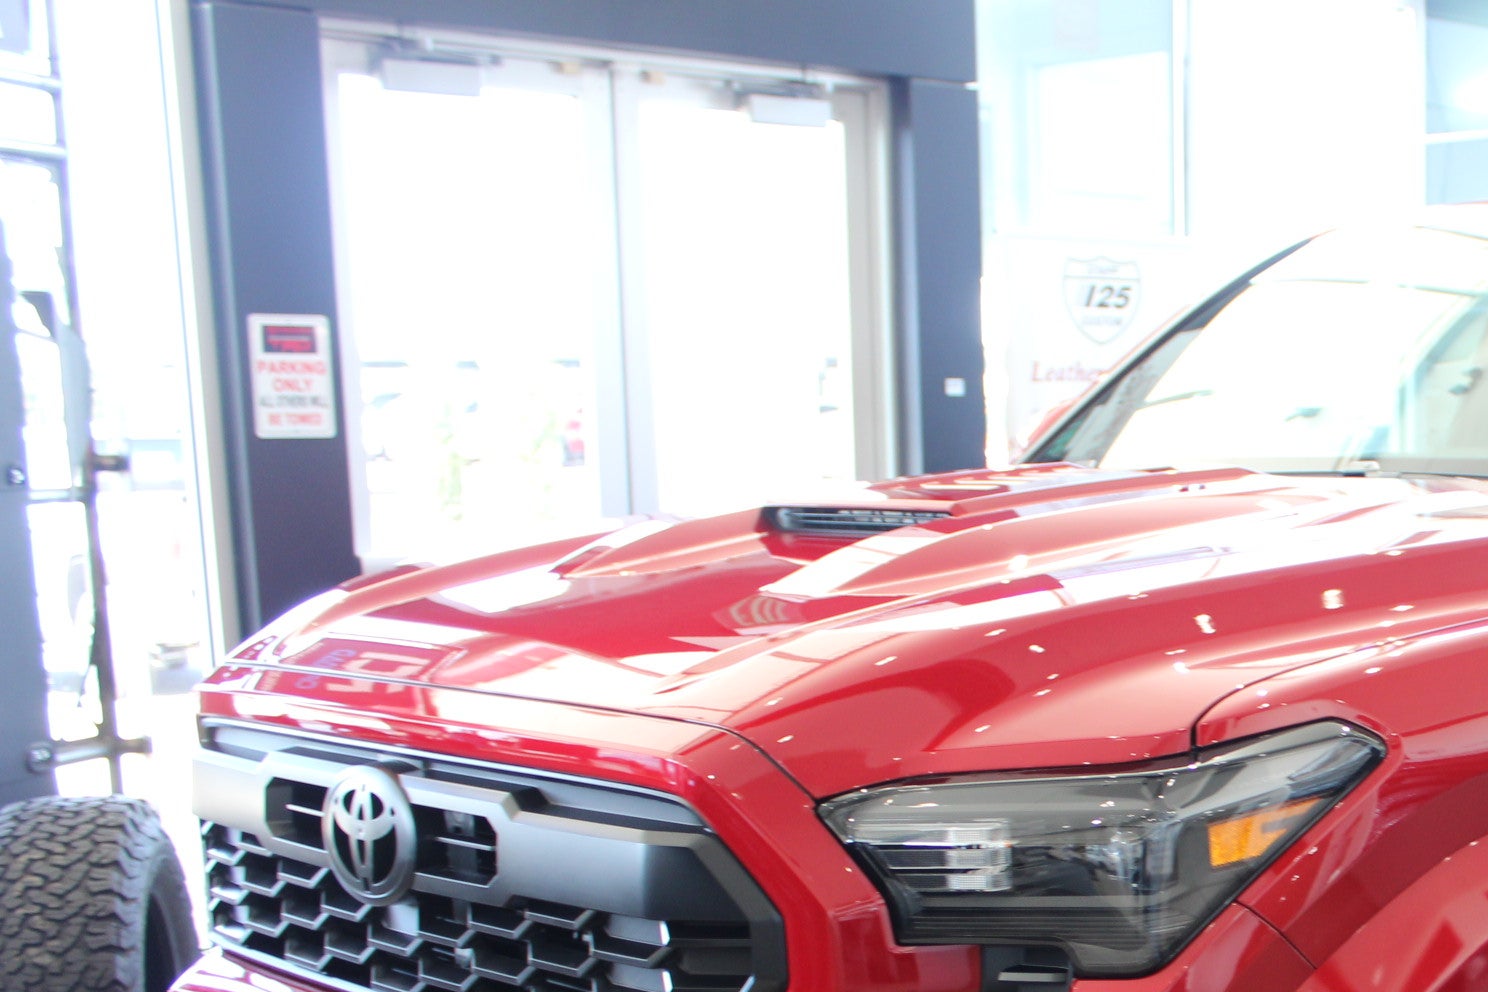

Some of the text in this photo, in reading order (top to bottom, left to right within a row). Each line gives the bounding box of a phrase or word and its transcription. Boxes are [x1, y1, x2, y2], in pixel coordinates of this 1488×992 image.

[1083, 284, 1133, 310] 125
[256, 360, 327, 375] PARKING
[272, 377, 313, 393] ONLY
[268, 412, 322, 427] BE TOWED
